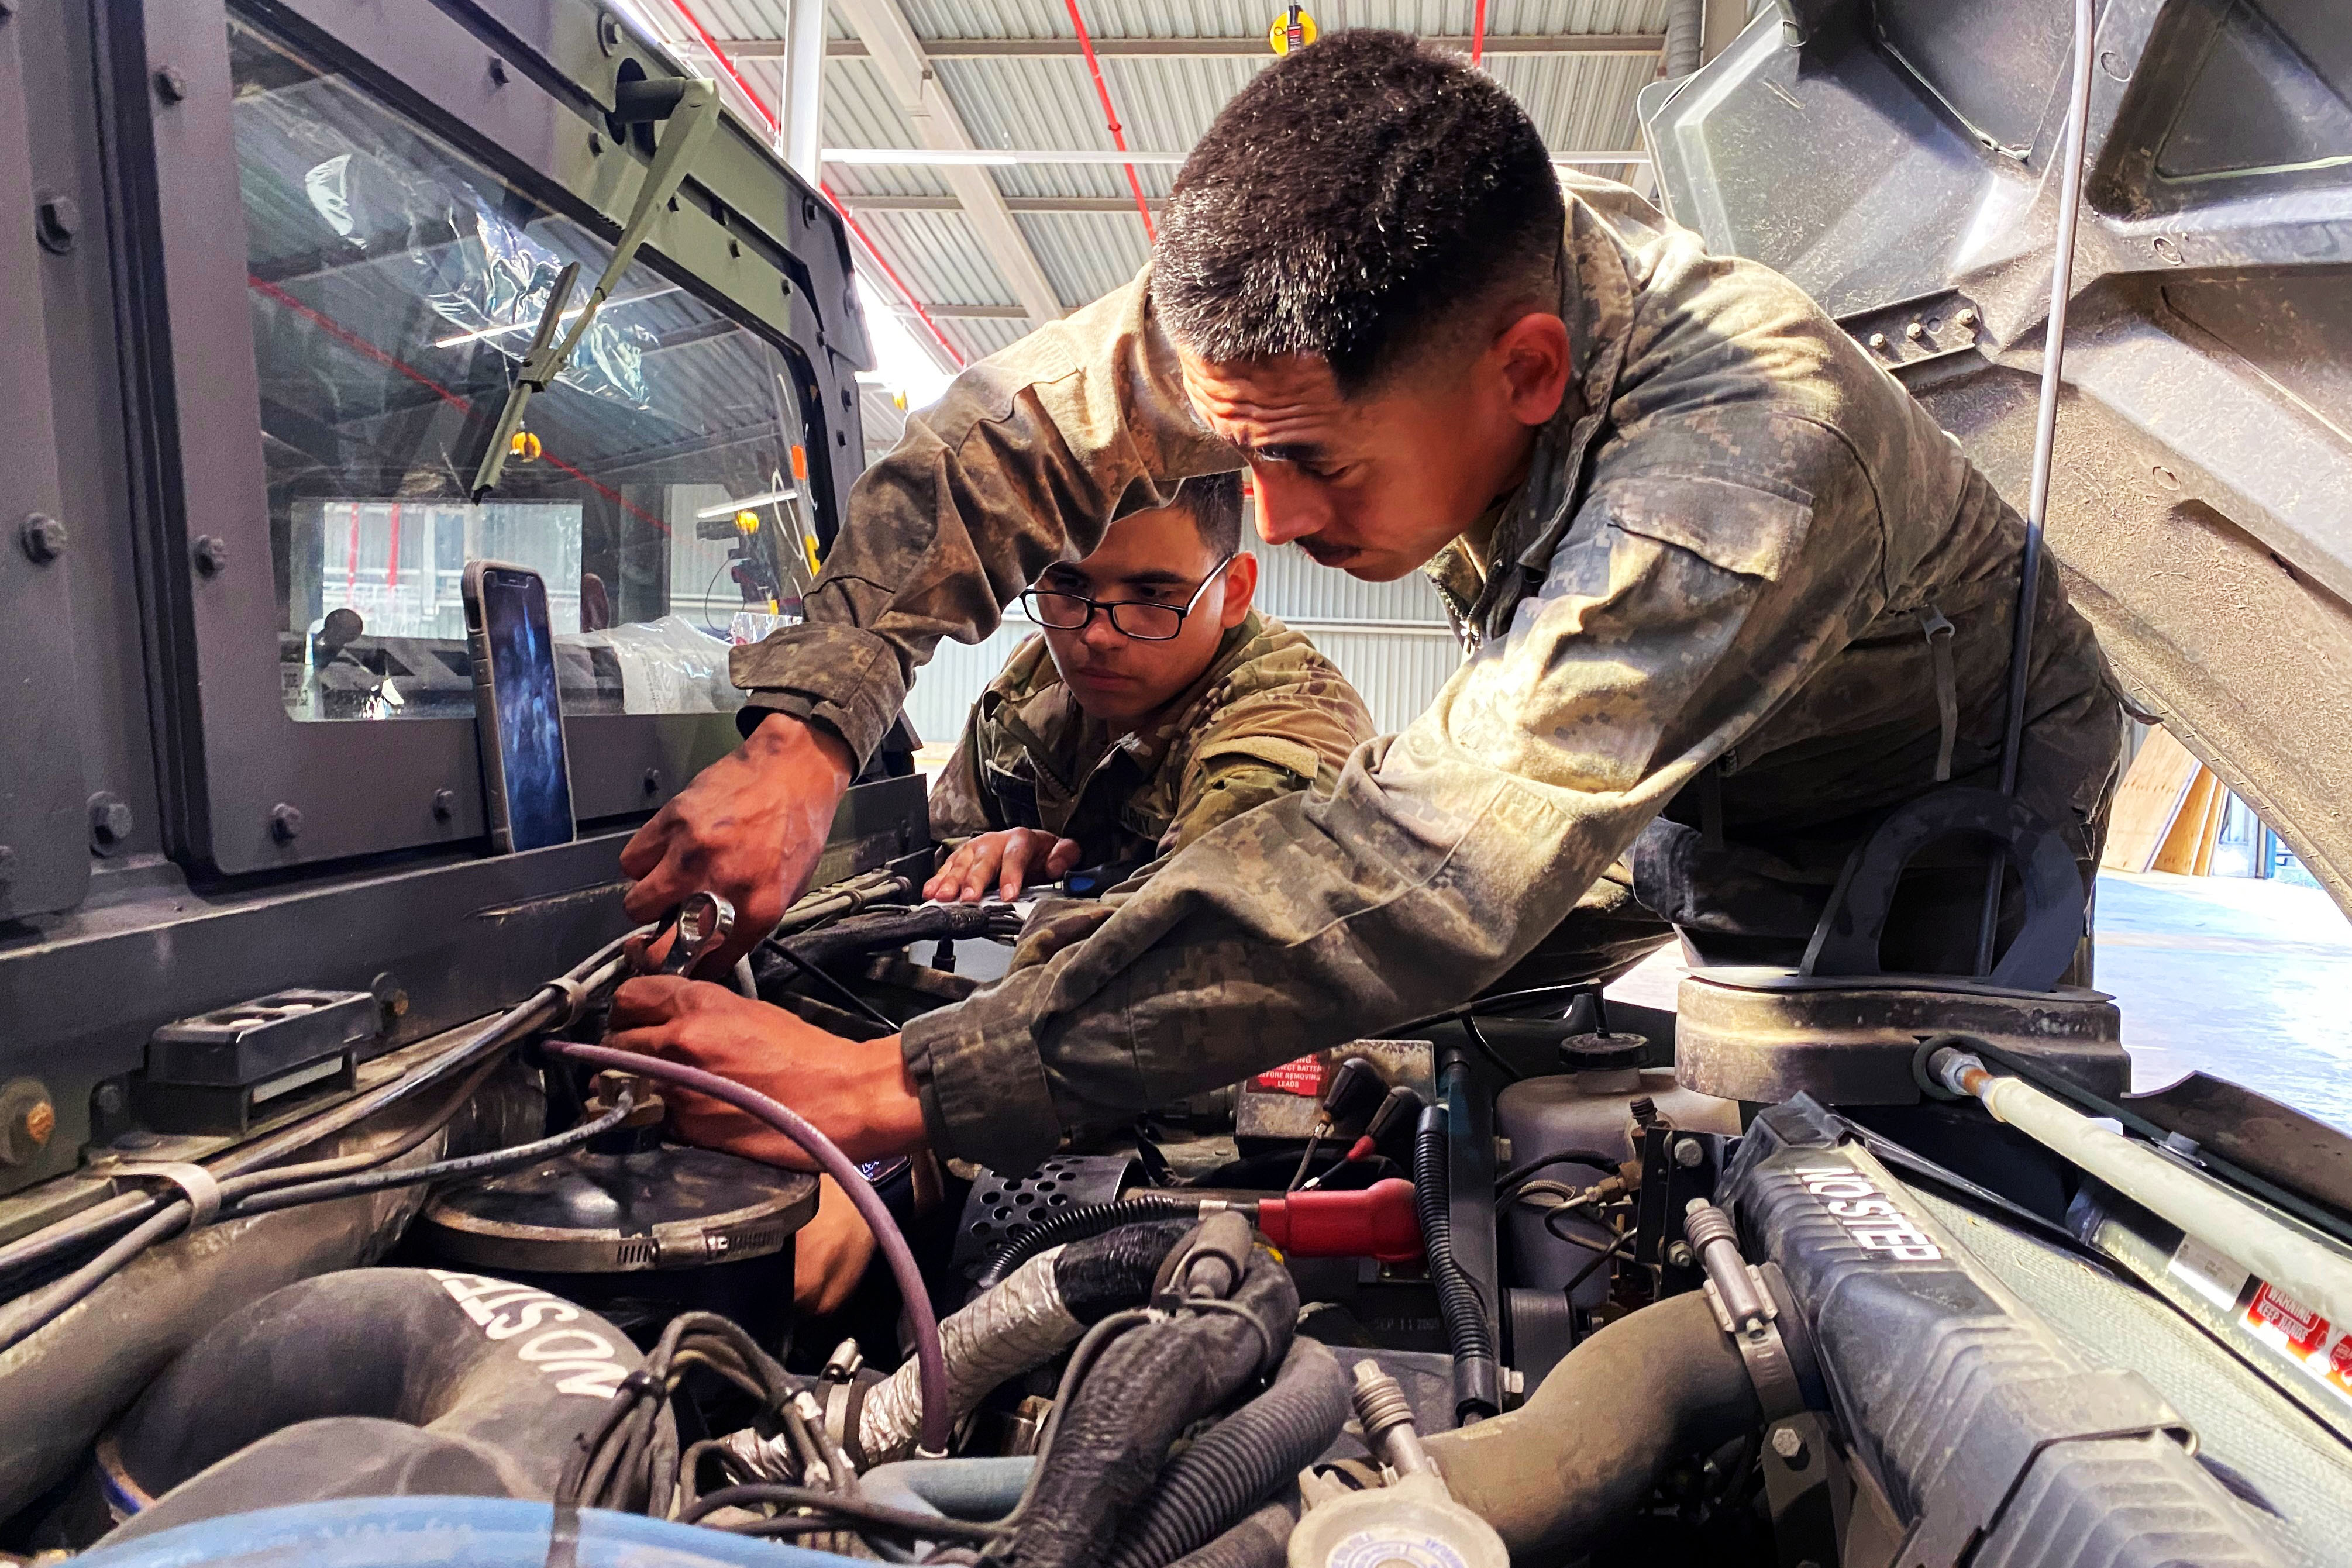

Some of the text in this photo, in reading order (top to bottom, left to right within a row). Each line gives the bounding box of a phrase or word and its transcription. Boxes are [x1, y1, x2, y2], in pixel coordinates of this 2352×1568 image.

[1285, 1072, 1321, 1081] REMOVING
[1795, 1167, 1942, 1260] NO STEP
[2257, 1301, 2280, 1324] KEEP
[2278, 1315, 2308, 1343] HANDS
[2268, 1286, 2312, 1325] WARNING
[518, 1329, 628, 1398] NO
